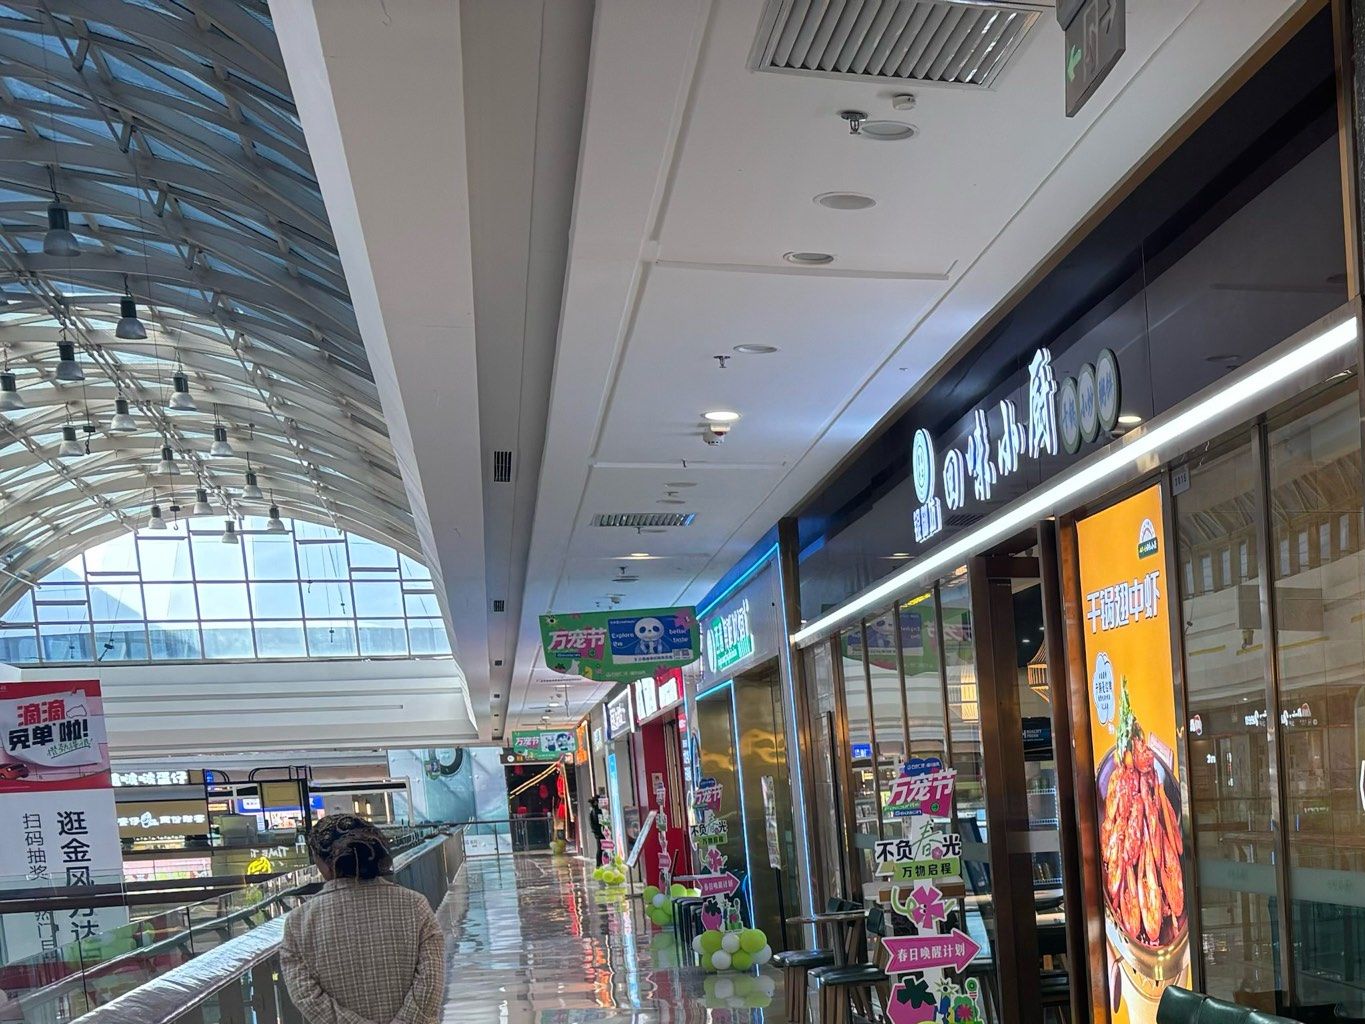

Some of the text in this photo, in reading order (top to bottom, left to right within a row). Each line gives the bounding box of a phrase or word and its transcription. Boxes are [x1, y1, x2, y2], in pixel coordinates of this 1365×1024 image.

[547, 627, 608, 650] 万宠节
[17, 699, 66, 727] 滴滴
[887, 768, 957, 804] 万宠节
[23, 813, 49, 881] 扫码抽奖
[876, 819, 961, 862] 不负春光
[902, 862, 952, 878] 万物启程
[898, 943, 966, 962] 春日唤醒计划
